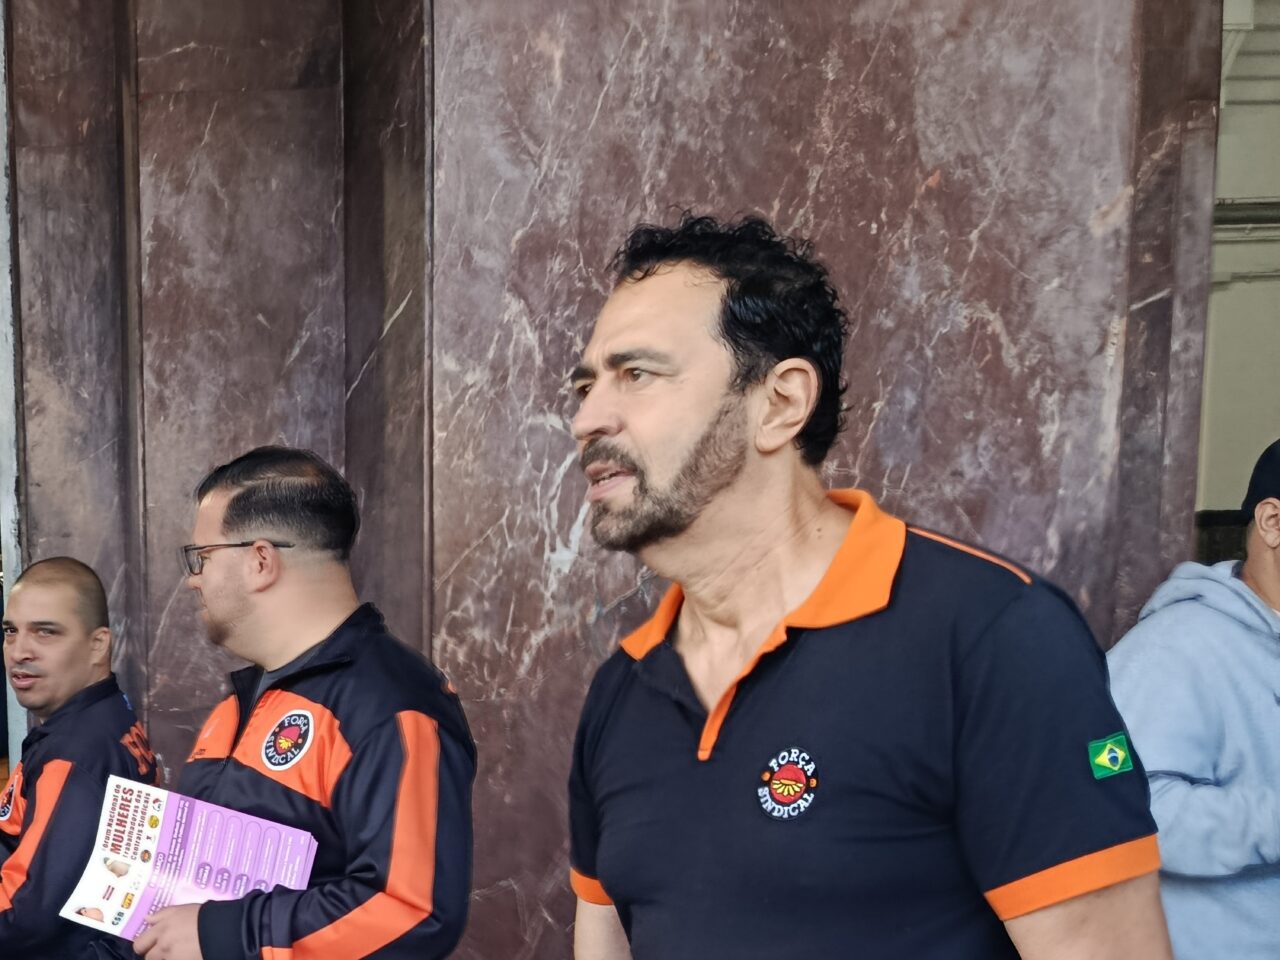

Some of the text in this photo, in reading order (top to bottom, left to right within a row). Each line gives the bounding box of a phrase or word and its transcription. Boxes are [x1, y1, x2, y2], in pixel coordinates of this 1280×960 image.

[768, 748, 816, 776] FORÇA
[757, 786, 815, 818] SINDICAL
[110, 787, 135, 855] MULHERES
